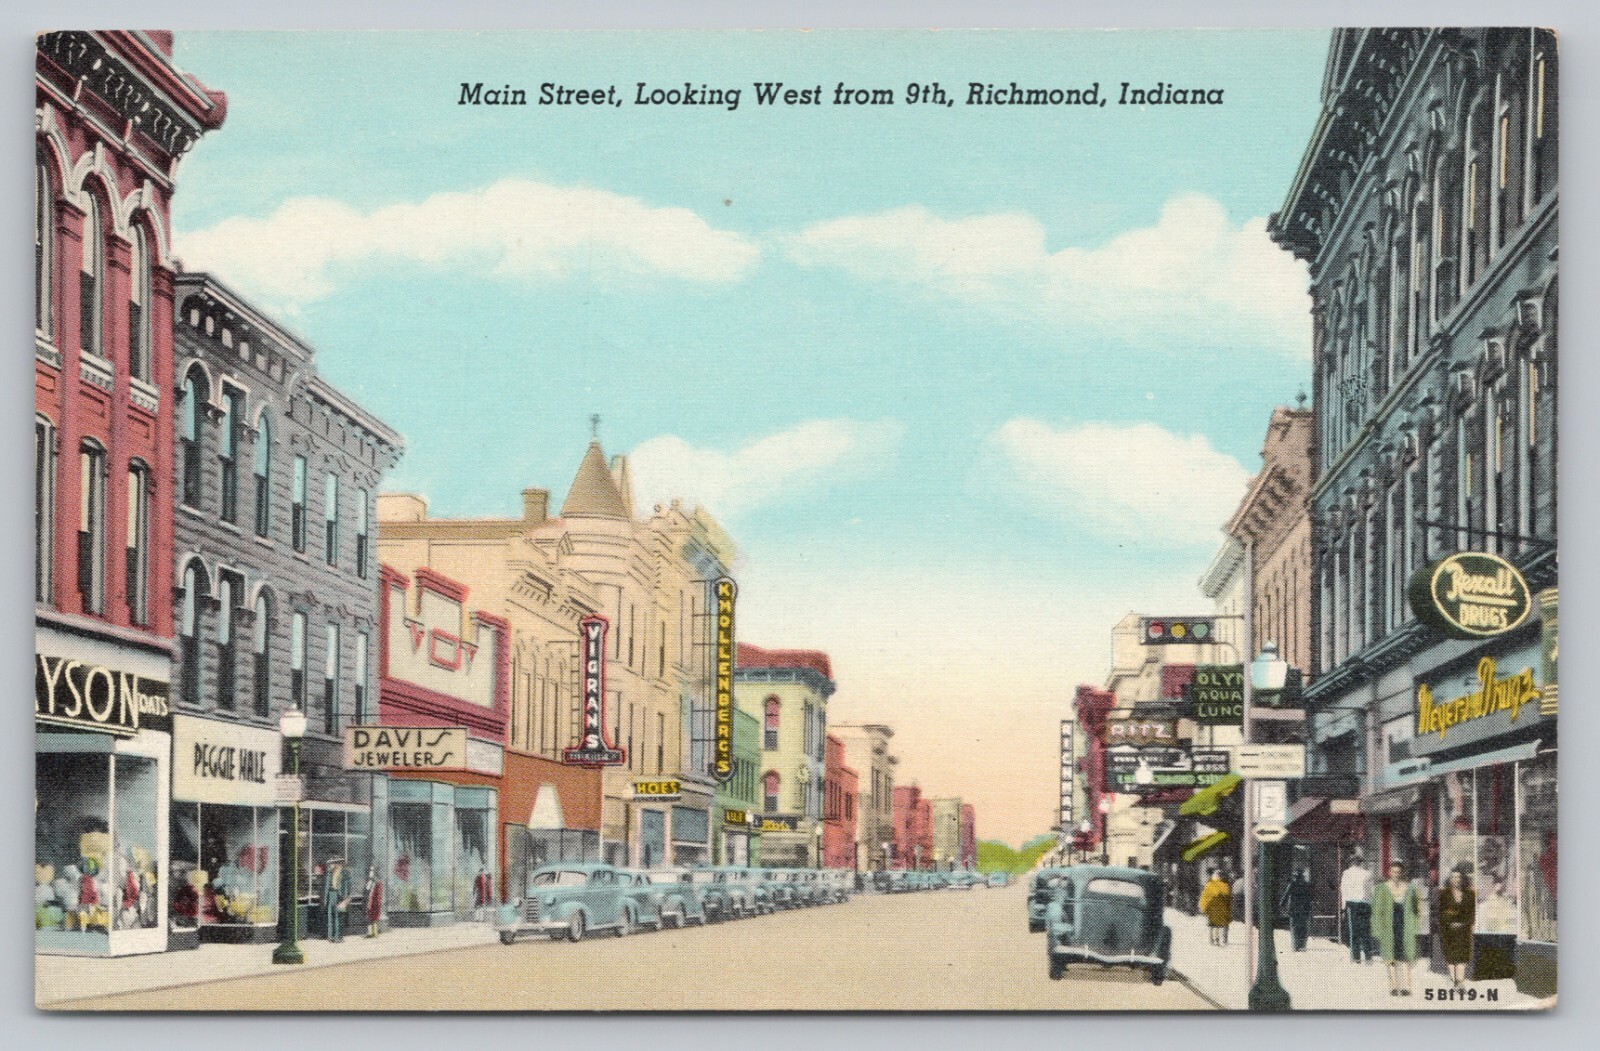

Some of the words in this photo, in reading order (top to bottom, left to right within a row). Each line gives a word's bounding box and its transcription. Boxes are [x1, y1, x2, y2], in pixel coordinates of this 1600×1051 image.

[1445, 562, 1517, 599] Rexall
[1460, 603, 1508, 629] DRUGS
[36, 654, 138, 729] YSON
[586, 625, 600, 748] VIGRANS
[354, 730, 451, 748] DAVIS
[1110, 724, 1171, 739] RITZ
[194, 742, 235, 781] PEGGIE
[354, 751, 453, 767] JEWELERS
